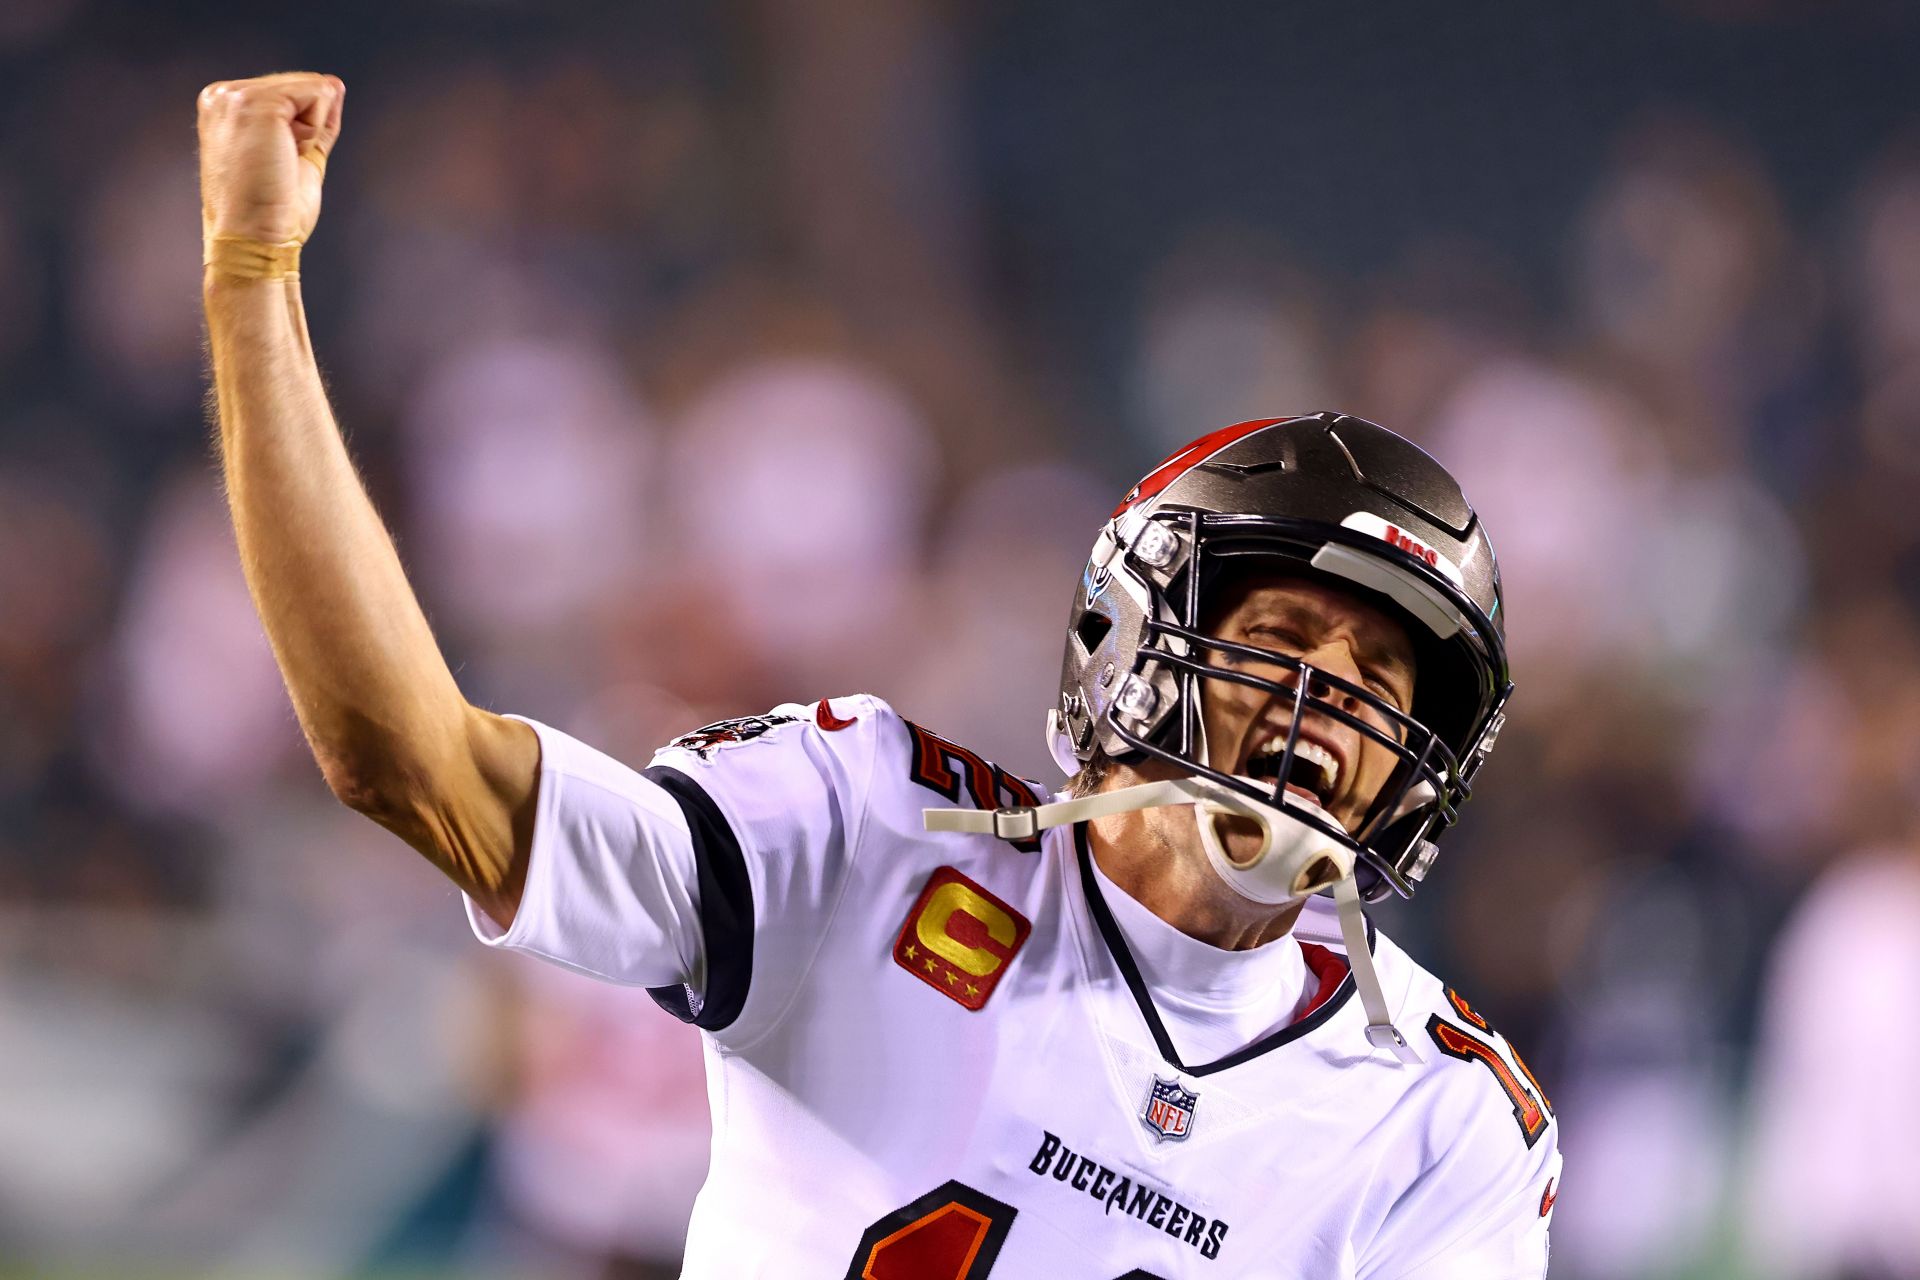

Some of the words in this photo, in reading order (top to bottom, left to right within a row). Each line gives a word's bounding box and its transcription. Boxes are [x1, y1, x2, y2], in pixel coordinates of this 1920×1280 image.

[916, 882, 1017, 977] C
[1149, 1099, 1184, 1132] NFL
[1425, 980, 1554, 1150] 1
[1028, 1130, 1229, 1260] BUCCANEERS
